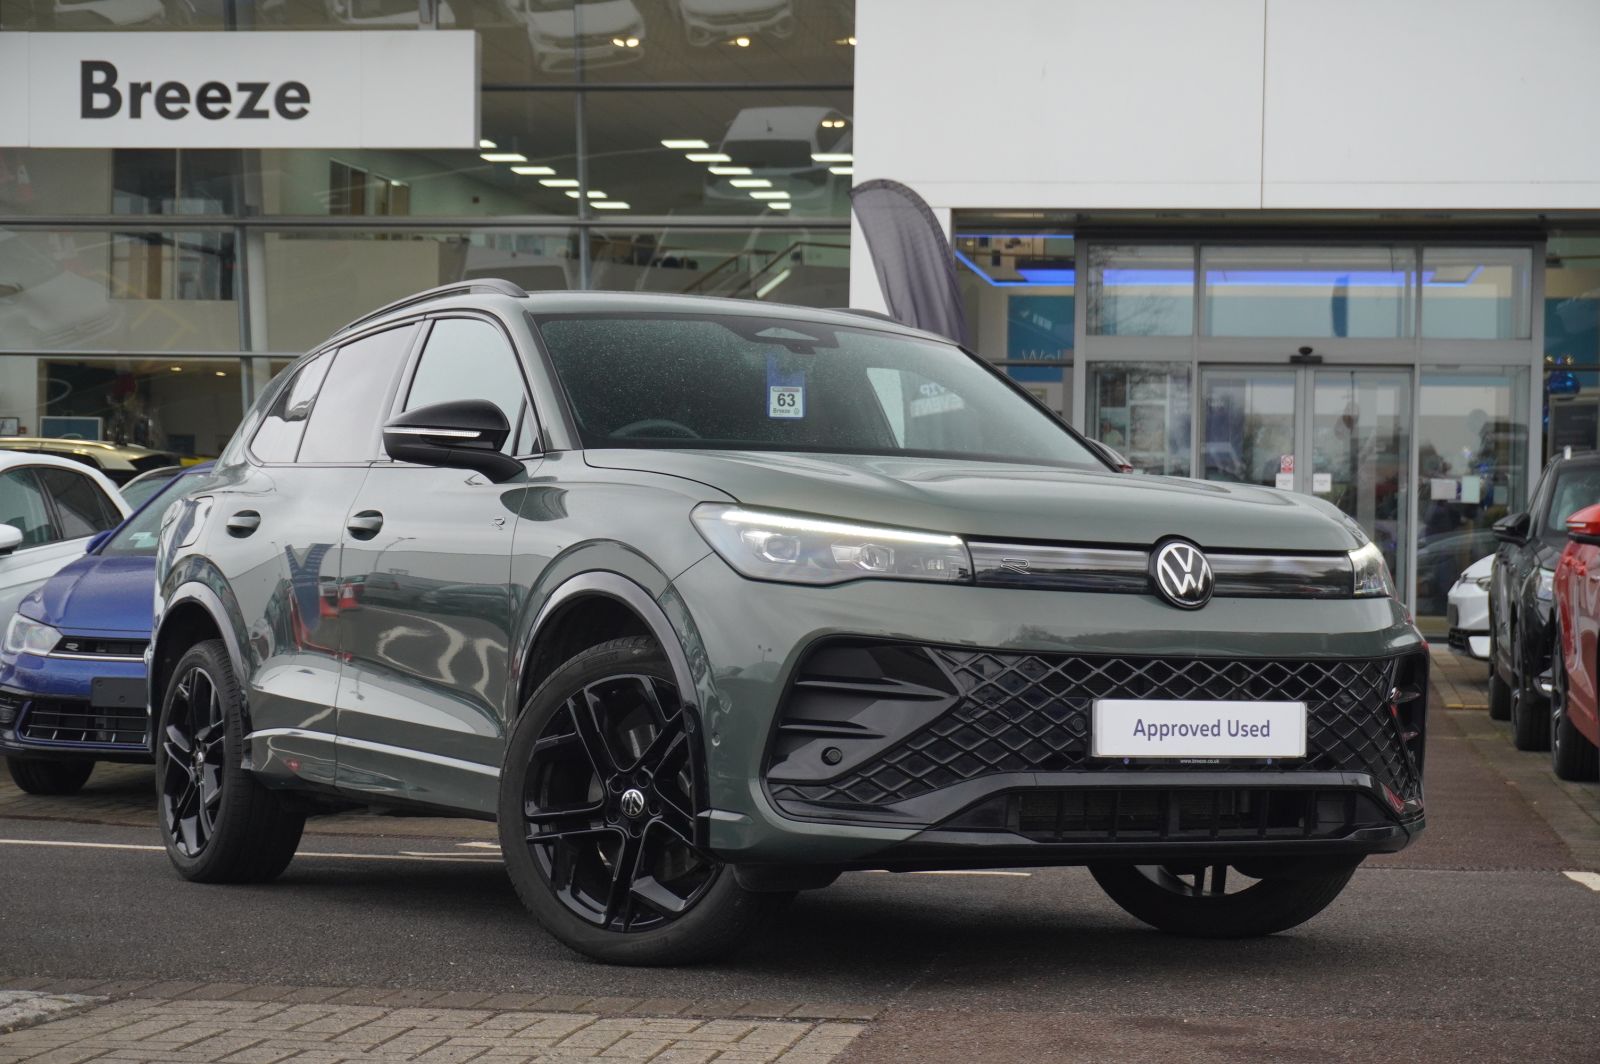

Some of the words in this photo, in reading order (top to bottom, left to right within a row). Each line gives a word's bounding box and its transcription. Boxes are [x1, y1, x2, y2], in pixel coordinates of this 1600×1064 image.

[80, 60, 311, 120] Breeze
[777, 393, 796, 407] 63
[1133, 719, 1221, 741] Approved
[1227, 720, 1271, 738] Used
